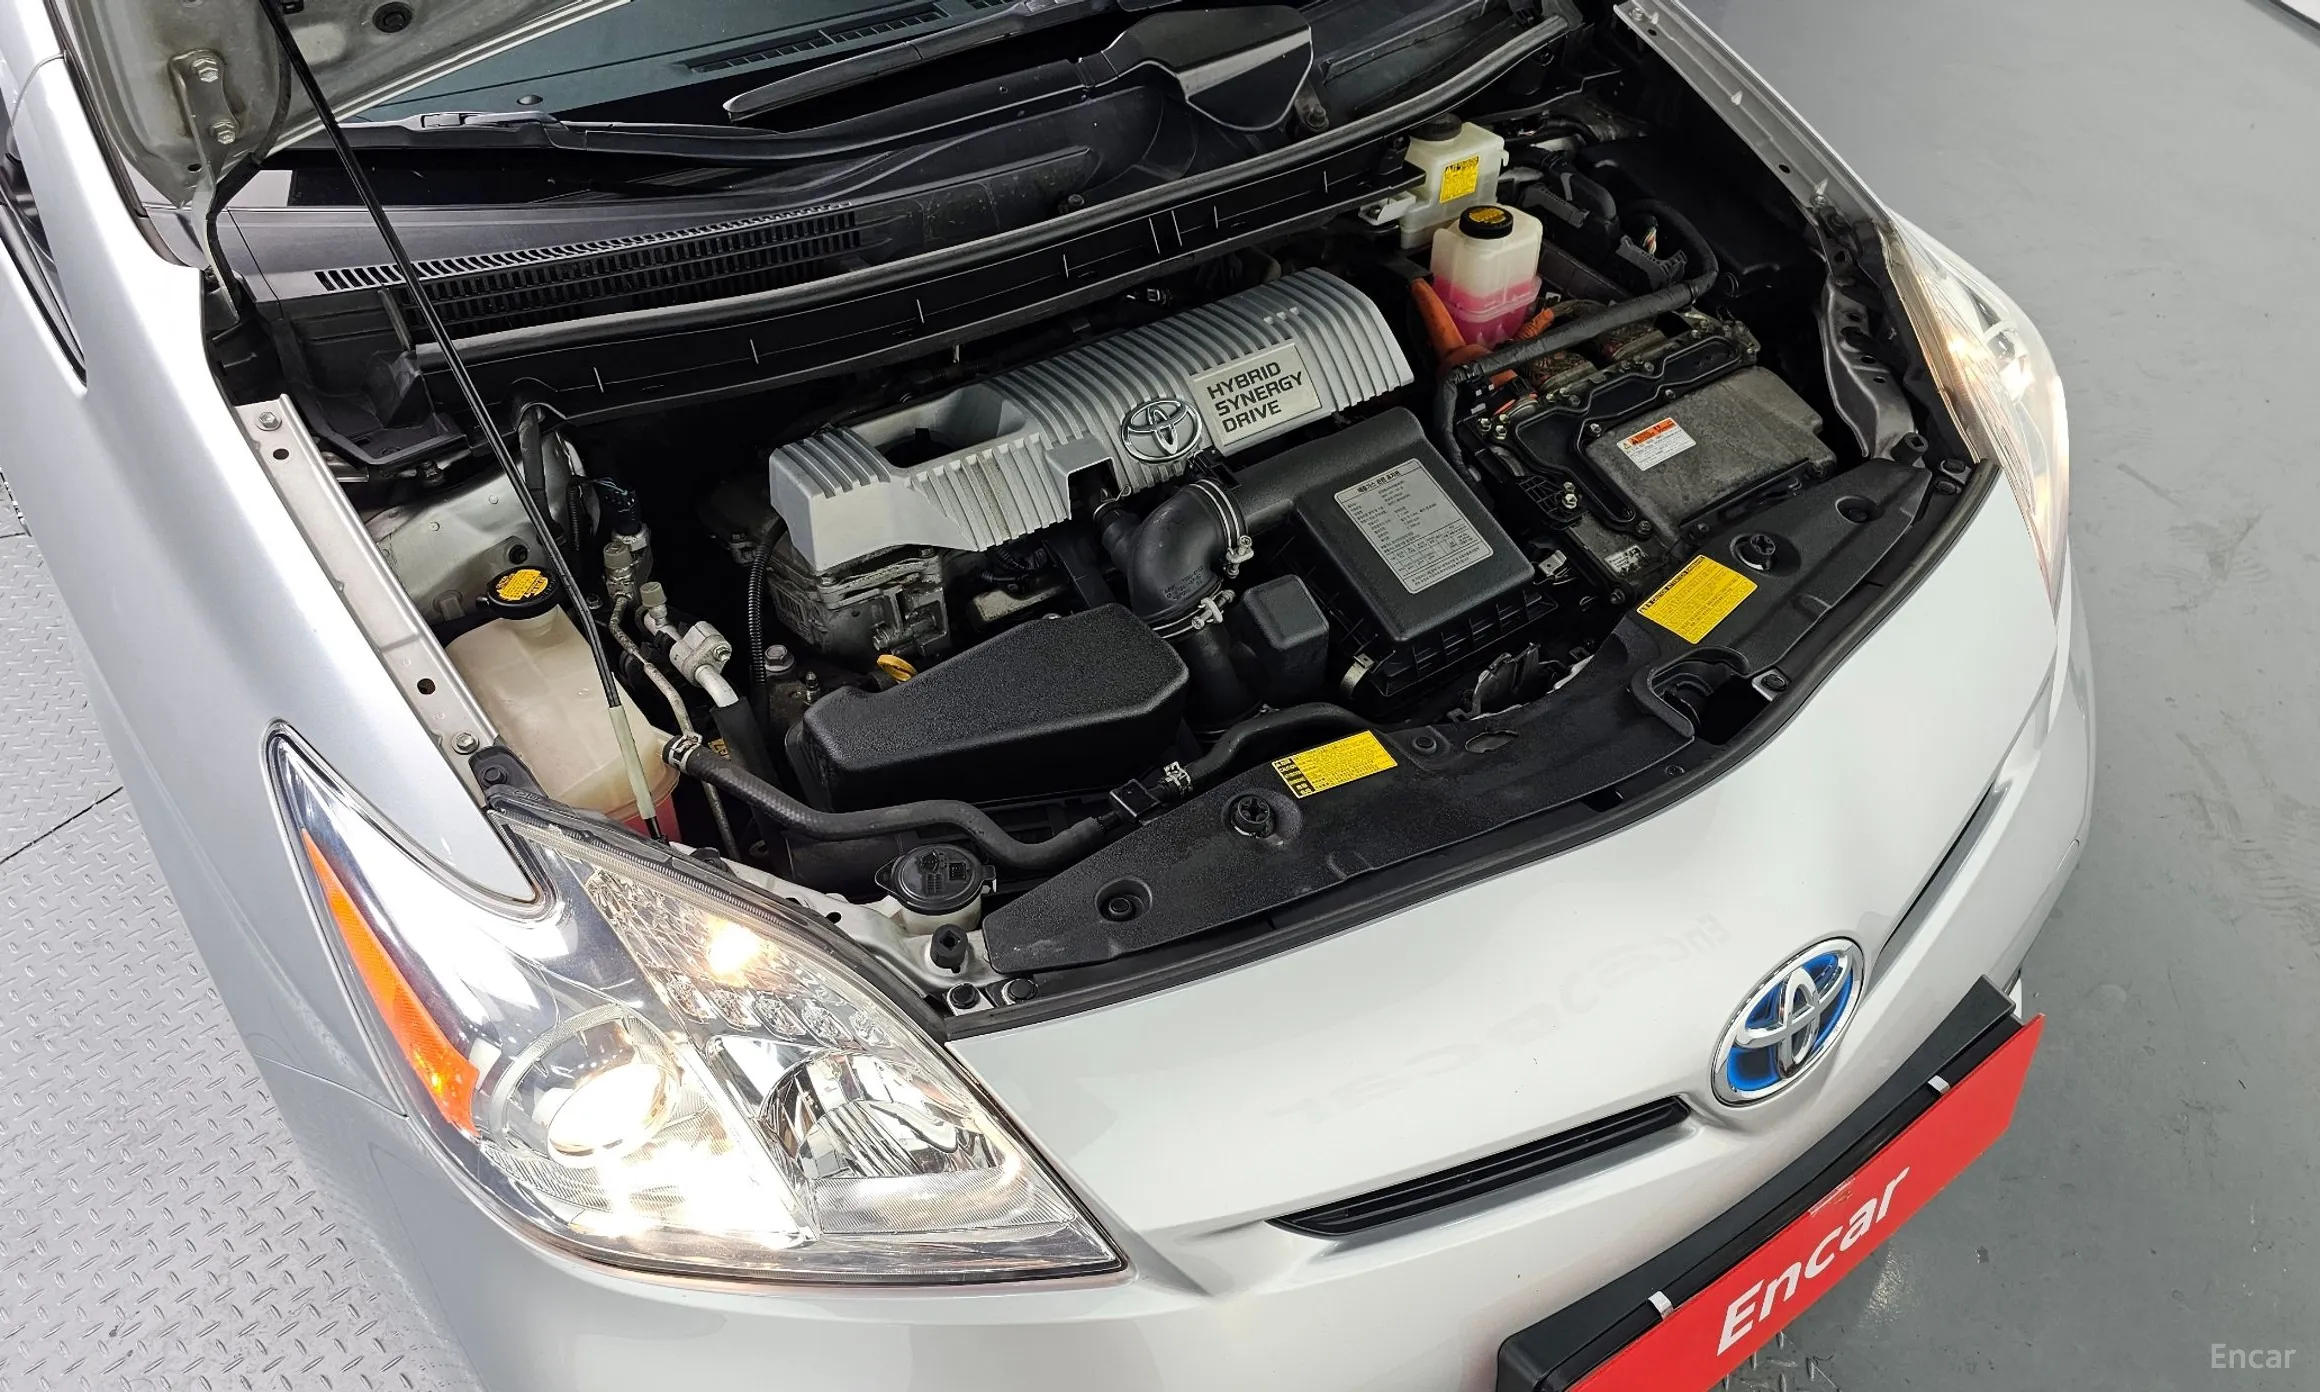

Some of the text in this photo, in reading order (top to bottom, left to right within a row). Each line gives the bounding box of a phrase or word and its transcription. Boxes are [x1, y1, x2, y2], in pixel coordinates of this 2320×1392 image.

[1207, 362, 1281, 400] HYBRID
[1215, 371, 1302, 416] SYNERGY
[1222, 400, 1282, 433] DRIVE
[1717, 1166, 1910, 1357] Encar
